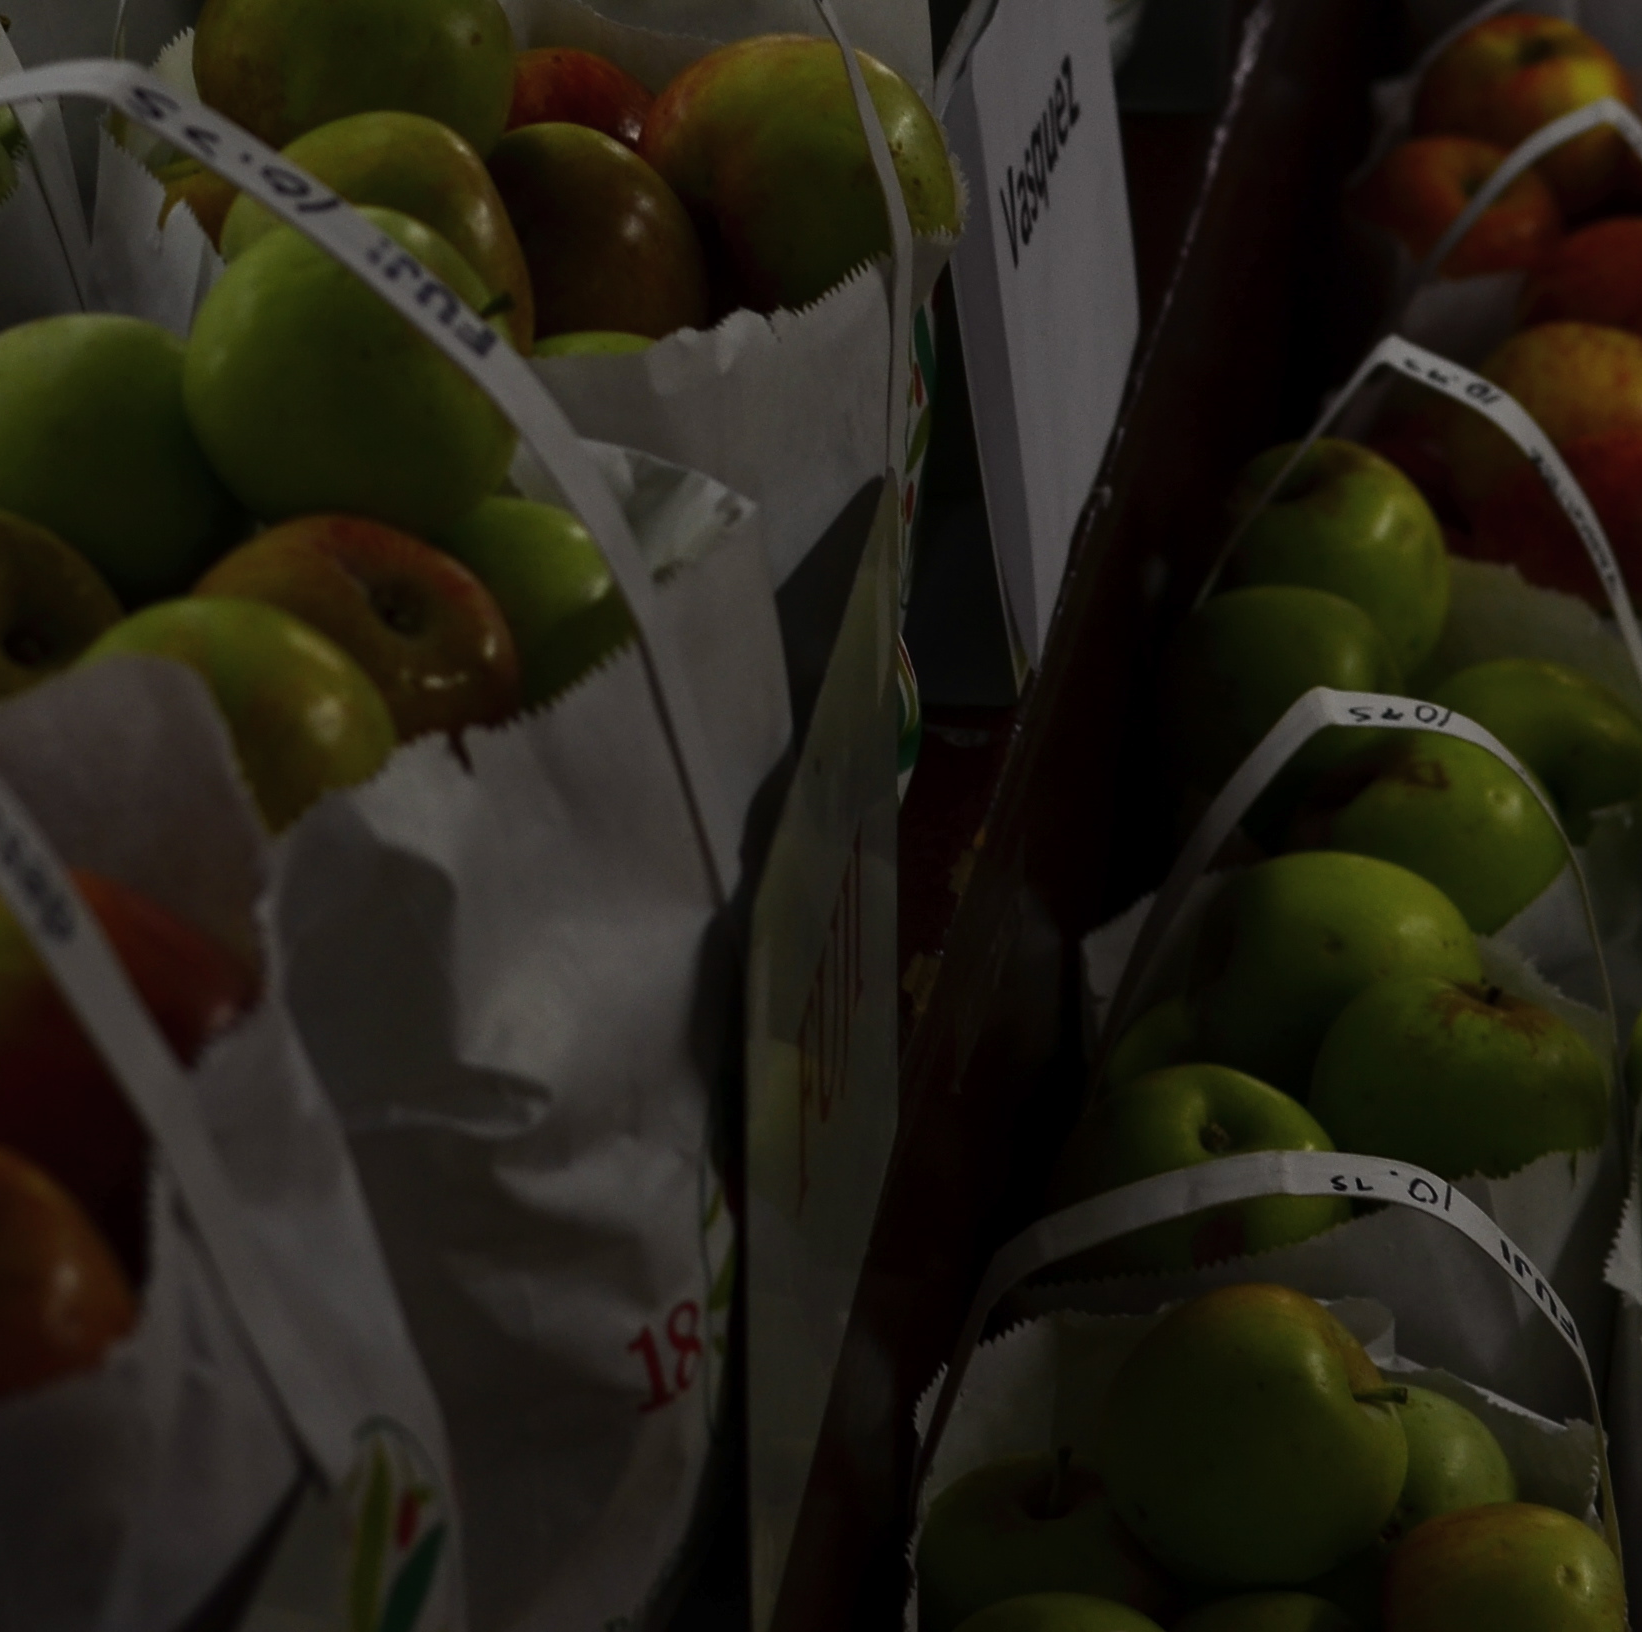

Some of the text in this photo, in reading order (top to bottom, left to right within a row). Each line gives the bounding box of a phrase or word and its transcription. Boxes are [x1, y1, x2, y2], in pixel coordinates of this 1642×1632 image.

[128, 86, 497, 357] FUJI 10.75
[999, 53, 1080, 270] Vasquez
[1330, 1170, 1578, 1345] FUJI 10.75
